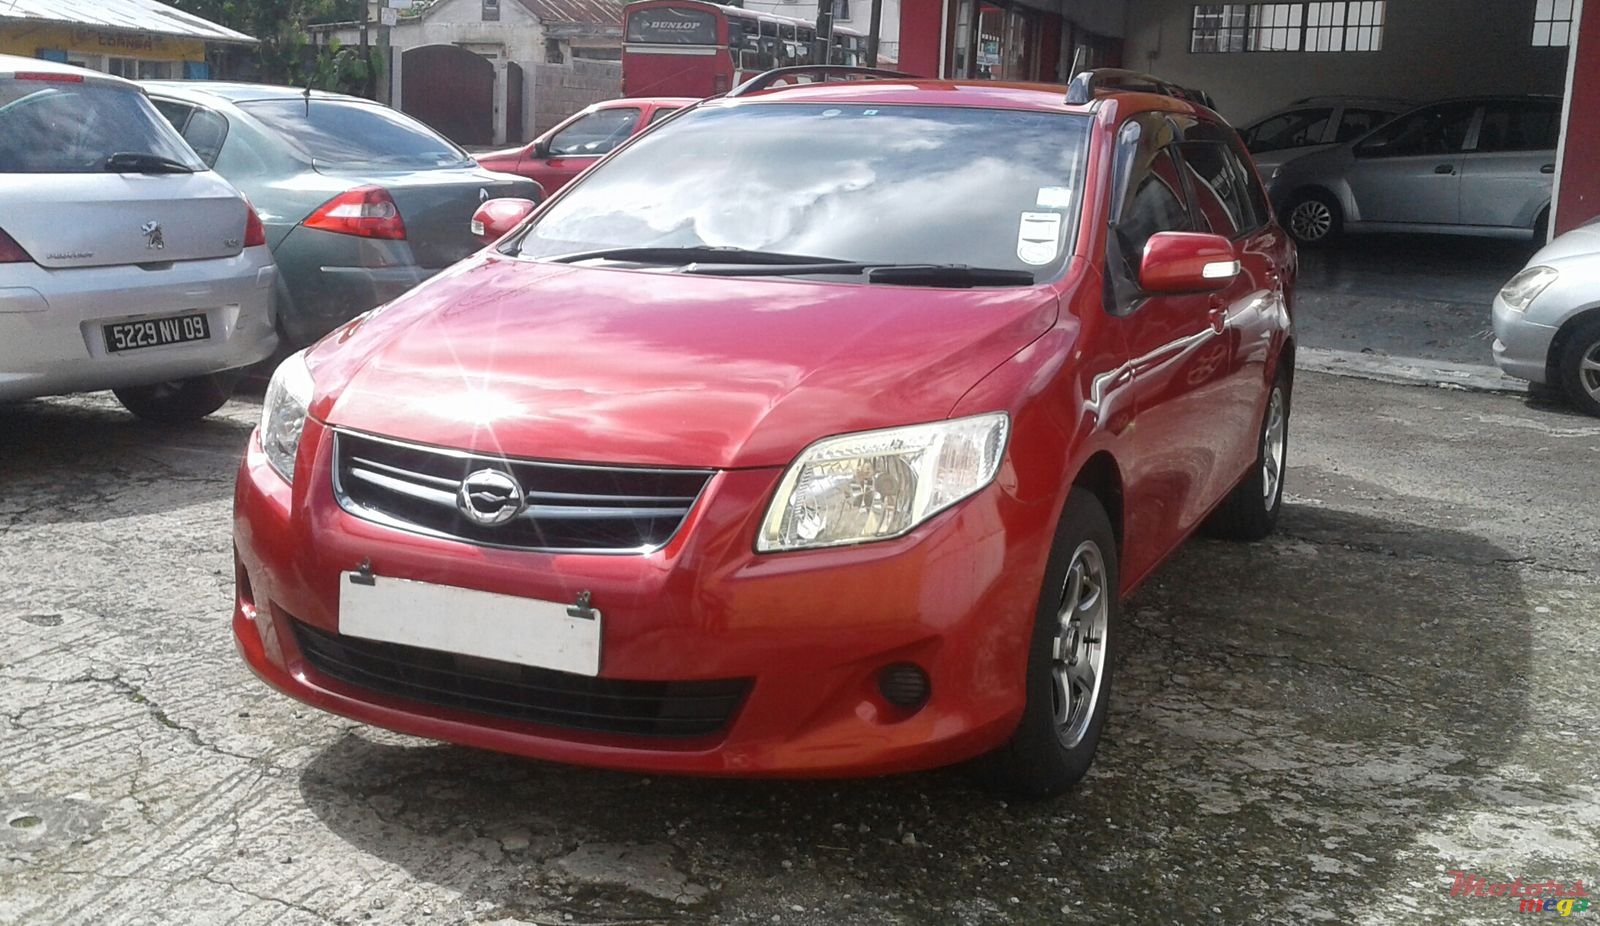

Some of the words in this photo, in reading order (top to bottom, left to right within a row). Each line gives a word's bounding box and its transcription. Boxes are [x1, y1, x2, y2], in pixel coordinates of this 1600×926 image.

[650, 21, 701, 29] DUNLOP
[113, 322, 158, 348] 5229
[159, 319, 180, 342] NV
[183, 316, 204, 339] 09
